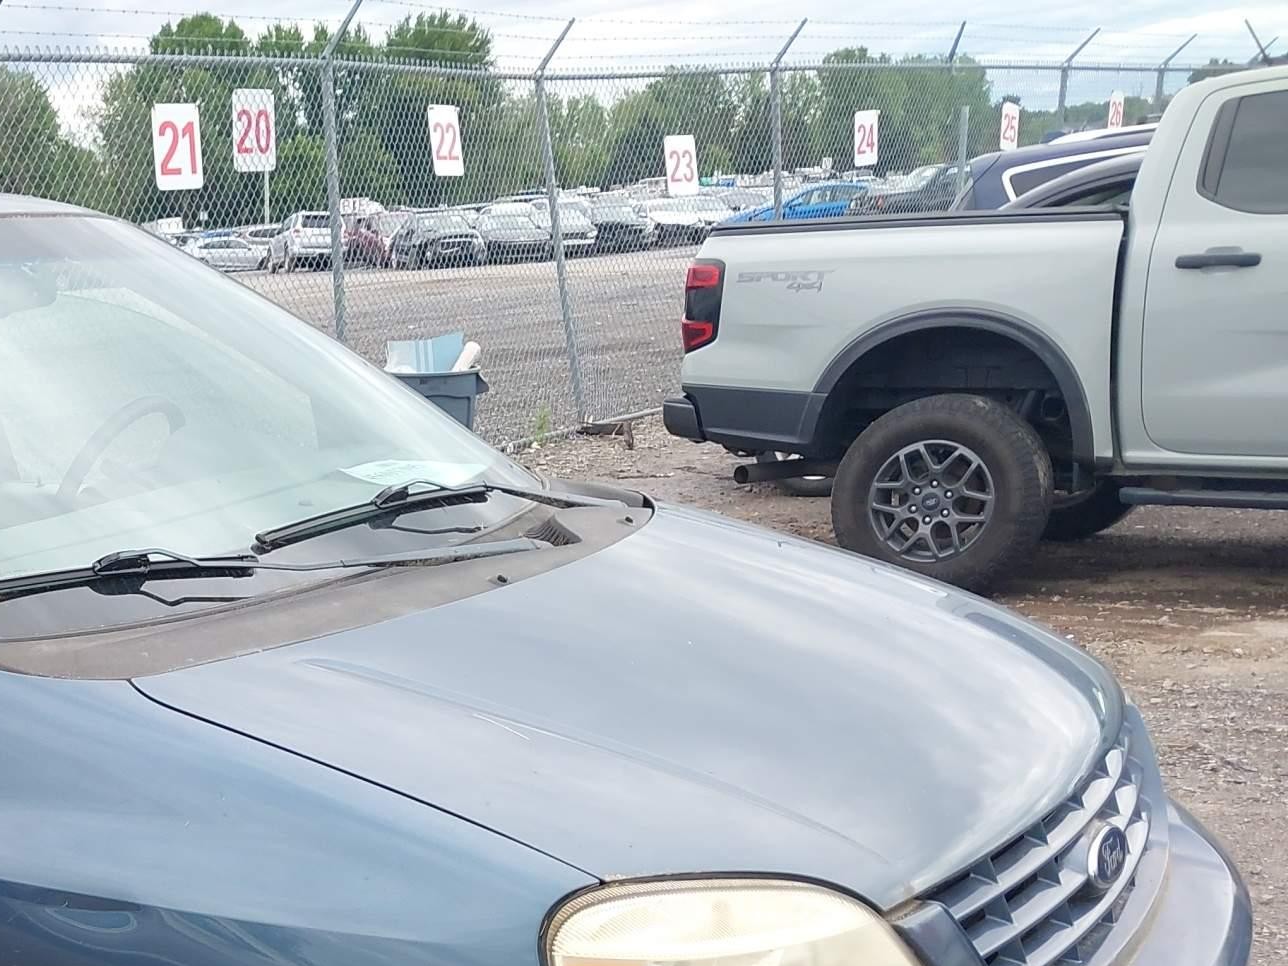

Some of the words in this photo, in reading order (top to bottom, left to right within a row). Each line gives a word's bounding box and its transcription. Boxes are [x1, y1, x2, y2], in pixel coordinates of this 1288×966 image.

[236, 108, 272, 155] 20
[433, 121, 460, 161] 22
[857, 123, 876, 155] 24
[1002, 113, 1017, 143] 25
[158, 120, 198, 176] 21
[669, 149, 695, 183] 23
